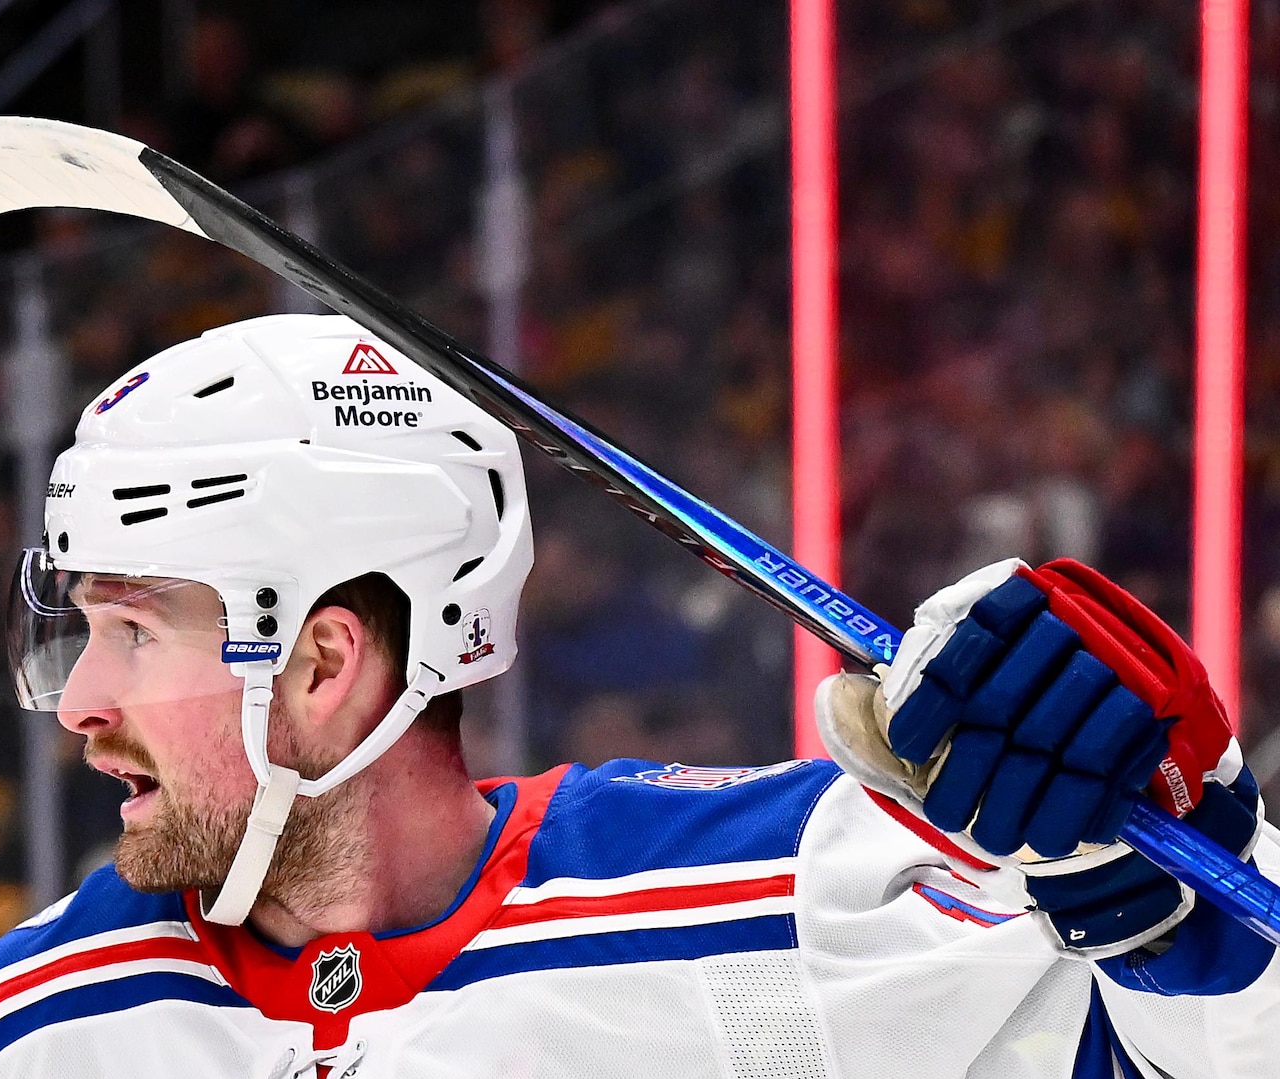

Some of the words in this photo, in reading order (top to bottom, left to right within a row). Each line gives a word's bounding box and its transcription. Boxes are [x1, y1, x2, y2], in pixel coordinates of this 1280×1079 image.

[312, 380, 432, 405] Benjamin
[754, 552, 879, 636] BAUER
[225, 644, 280, 653] BAUER
[322, 963, 352, 1001] NHL
